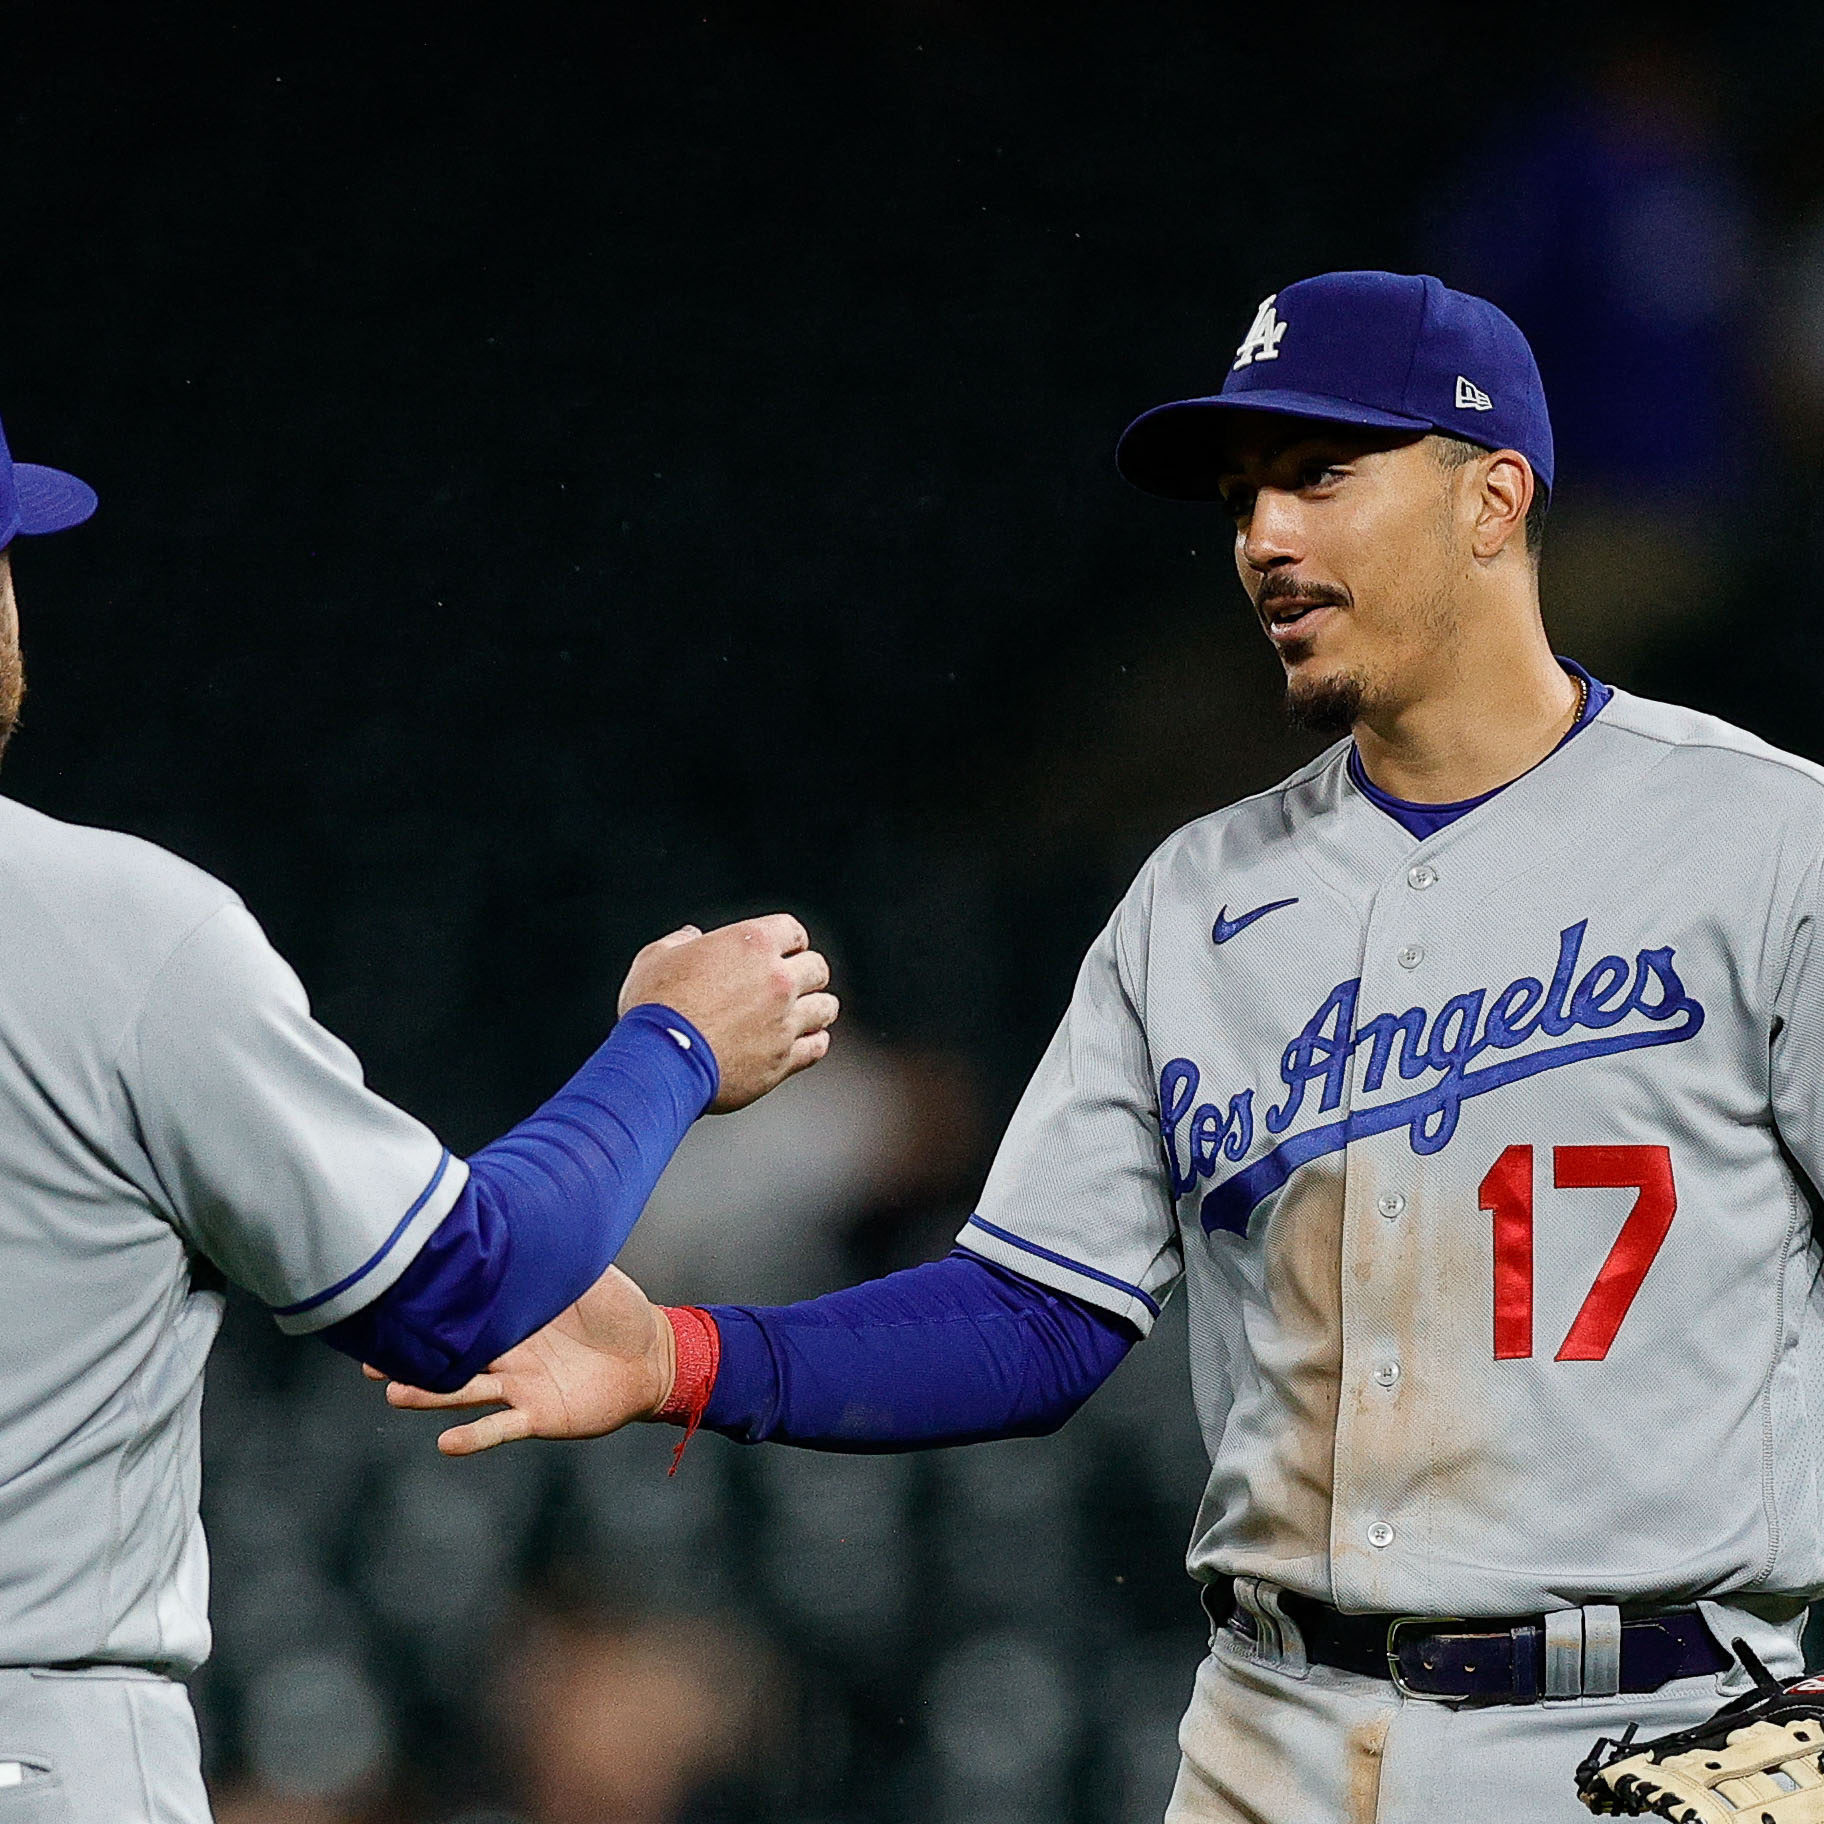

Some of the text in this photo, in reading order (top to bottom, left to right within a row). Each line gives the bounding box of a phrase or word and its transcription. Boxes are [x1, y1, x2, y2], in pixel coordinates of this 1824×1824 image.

[1233, 294, 1287, 370] LA
[1160, 918, 1691, 1200] Los Angeles
[1478, 1144, 1677, 1362] 17
